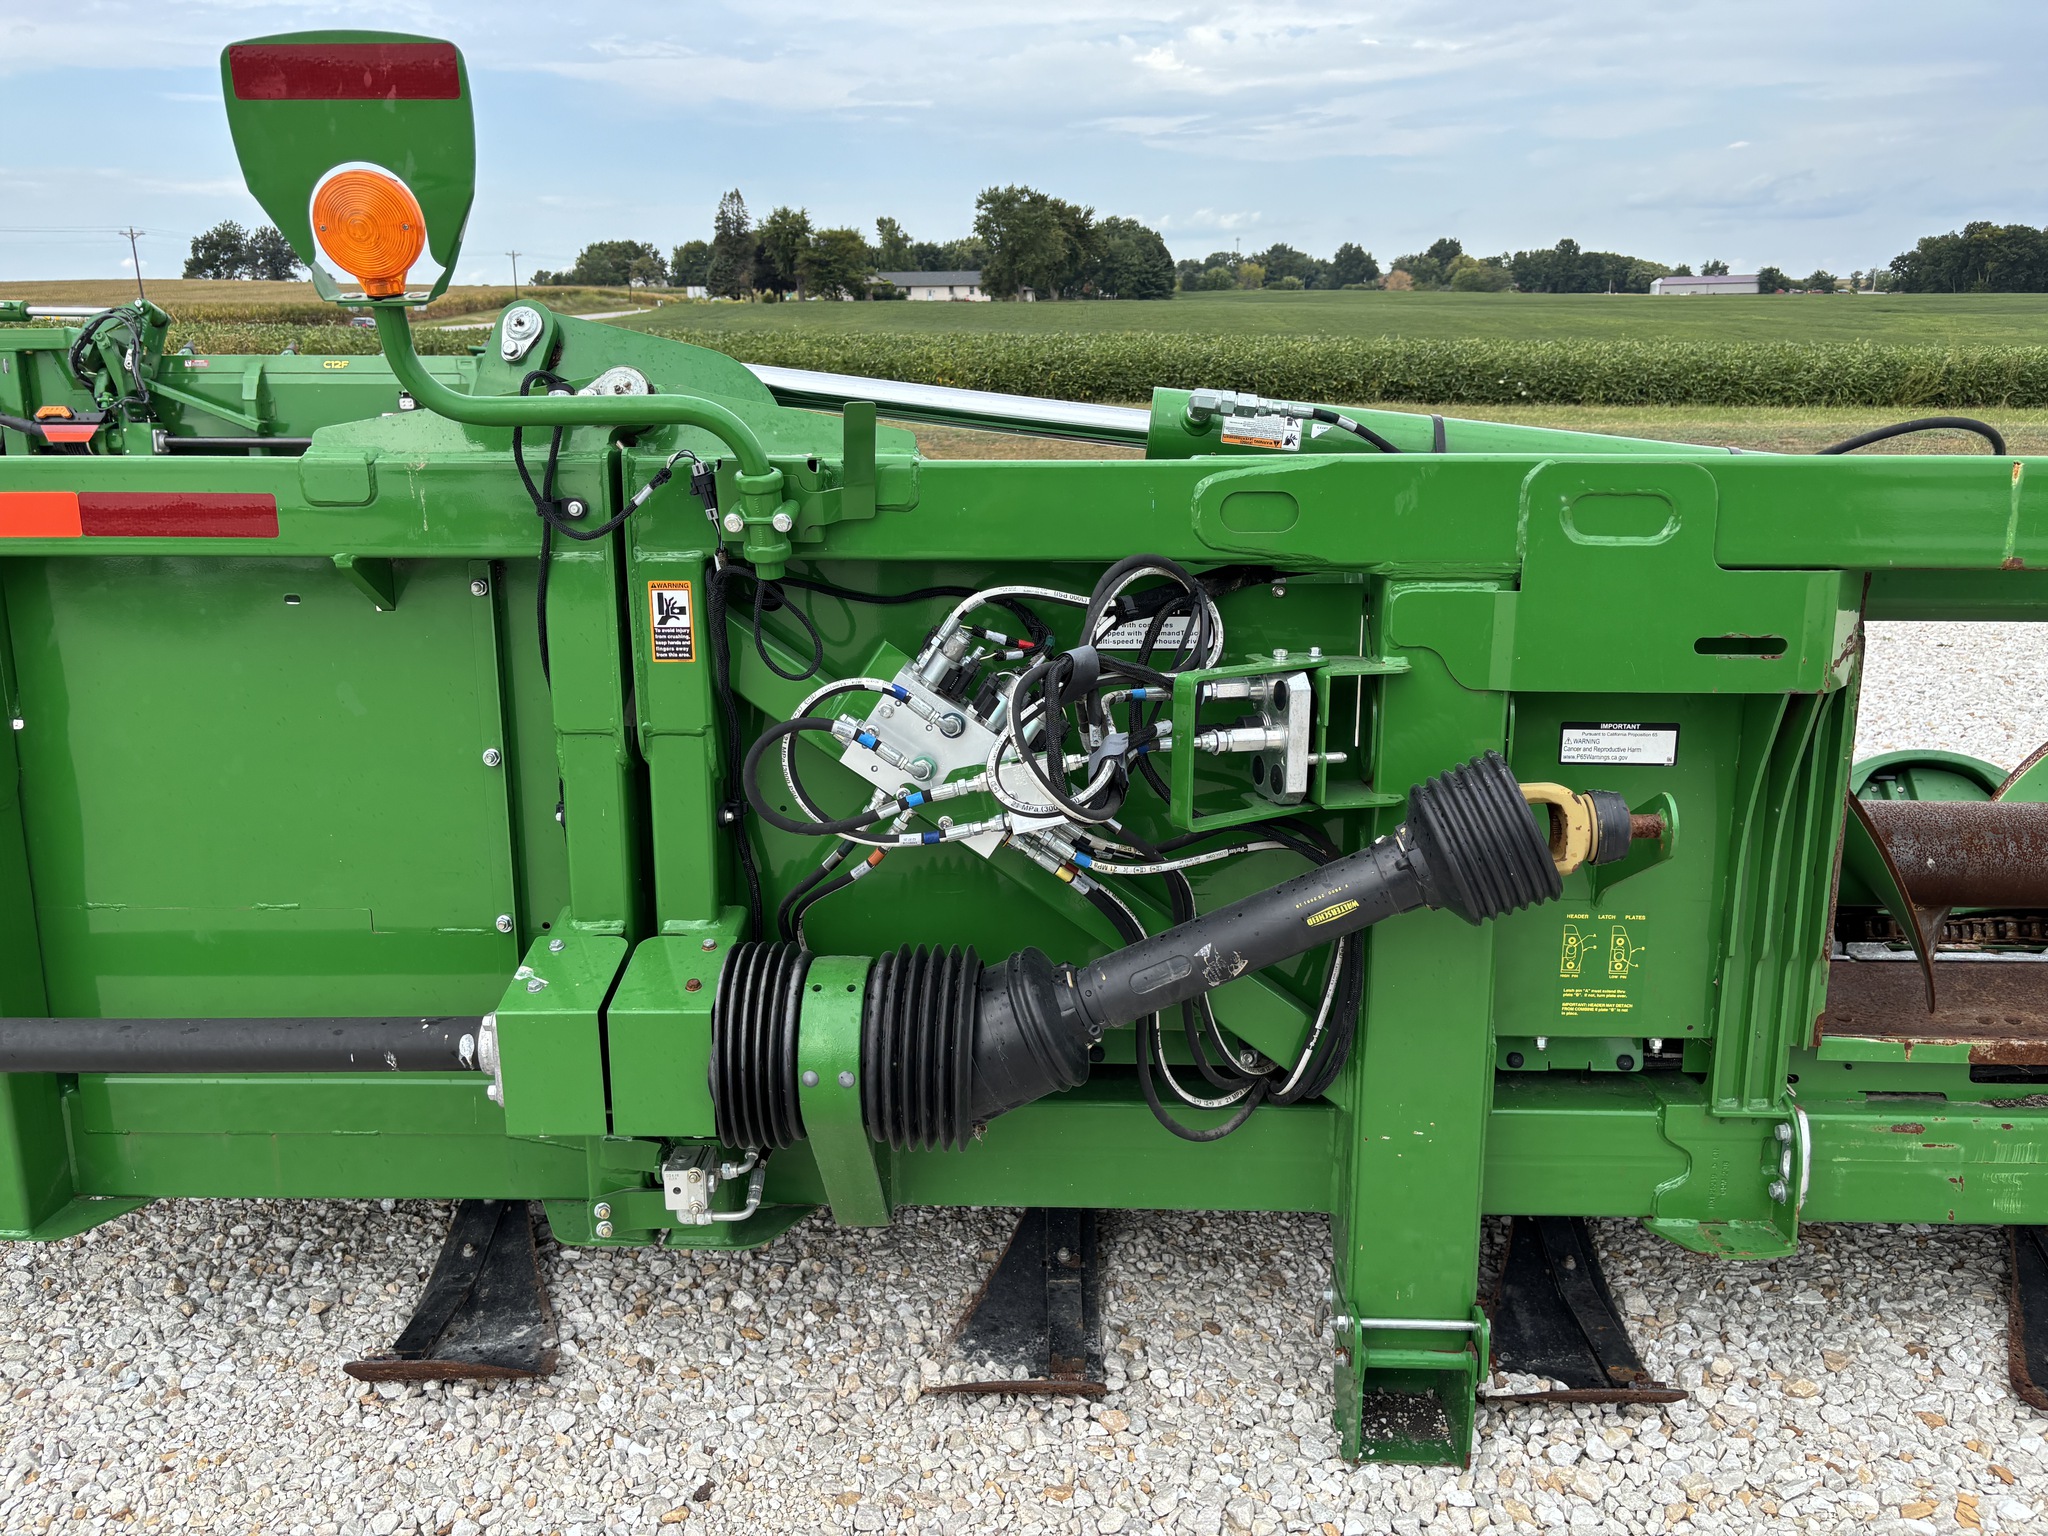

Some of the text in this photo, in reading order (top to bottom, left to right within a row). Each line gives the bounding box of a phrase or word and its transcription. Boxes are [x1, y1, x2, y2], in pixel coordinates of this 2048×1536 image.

[323, 360, 349, 369] C12F
[1094, 863, 1108, 871] MPa
[1307, 900, 1360, 926] WALTERSCHEID
